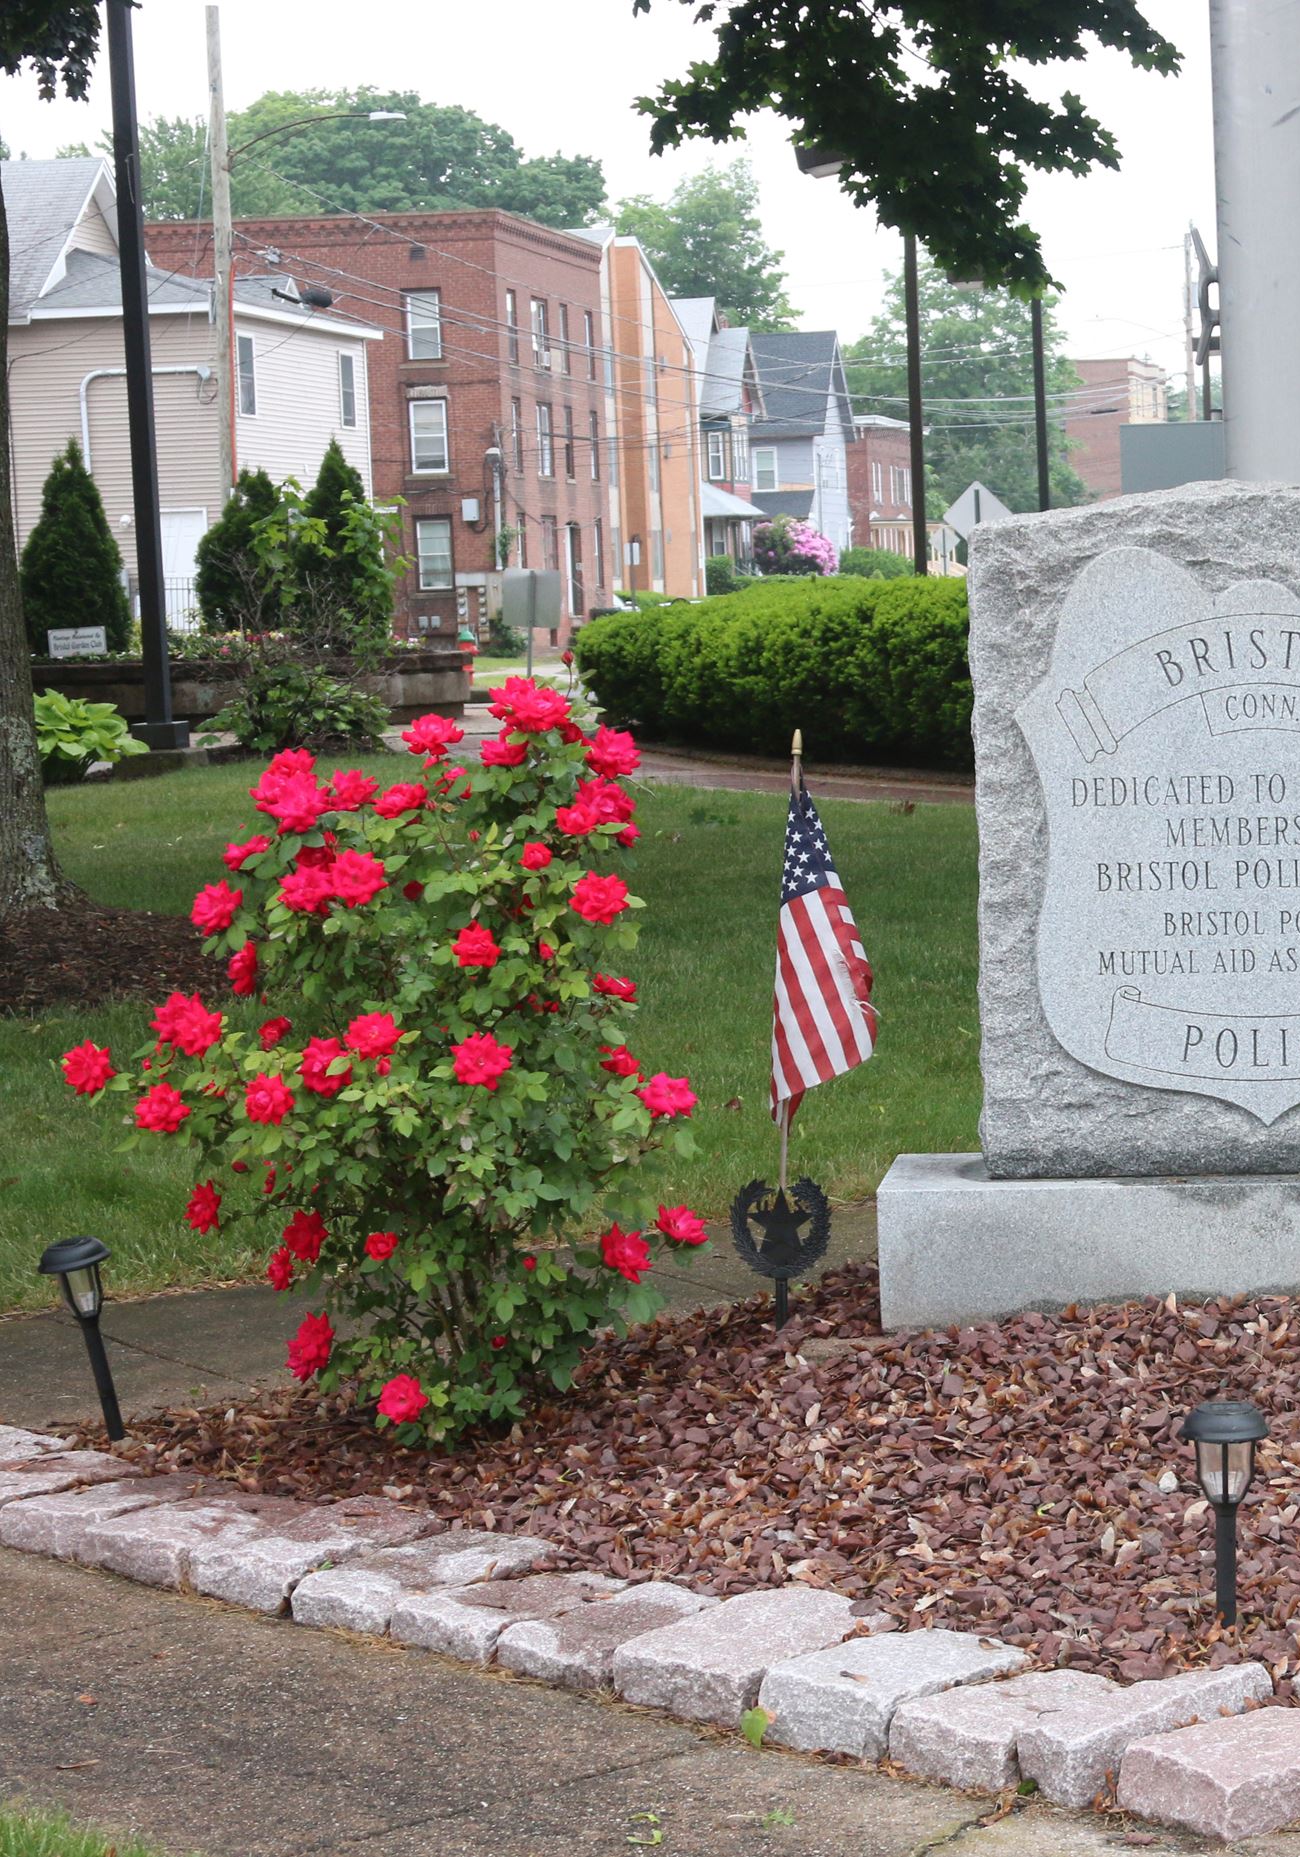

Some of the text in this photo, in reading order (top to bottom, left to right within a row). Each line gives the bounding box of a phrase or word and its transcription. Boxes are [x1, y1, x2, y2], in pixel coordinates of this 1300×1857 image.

[1225, 692, 1300, 722] CONN.
[1071, 774, 1235, 808] DEDICATED
[1252, 772, 1287, 804] TO
[1096, 861, 1219, 892] BRISTOL
[1162, 910, 1266, 937] BRISTOL
[1098, 949, 1201, 977] MUTUAL
[1212, 947, 1257, 973] AID
